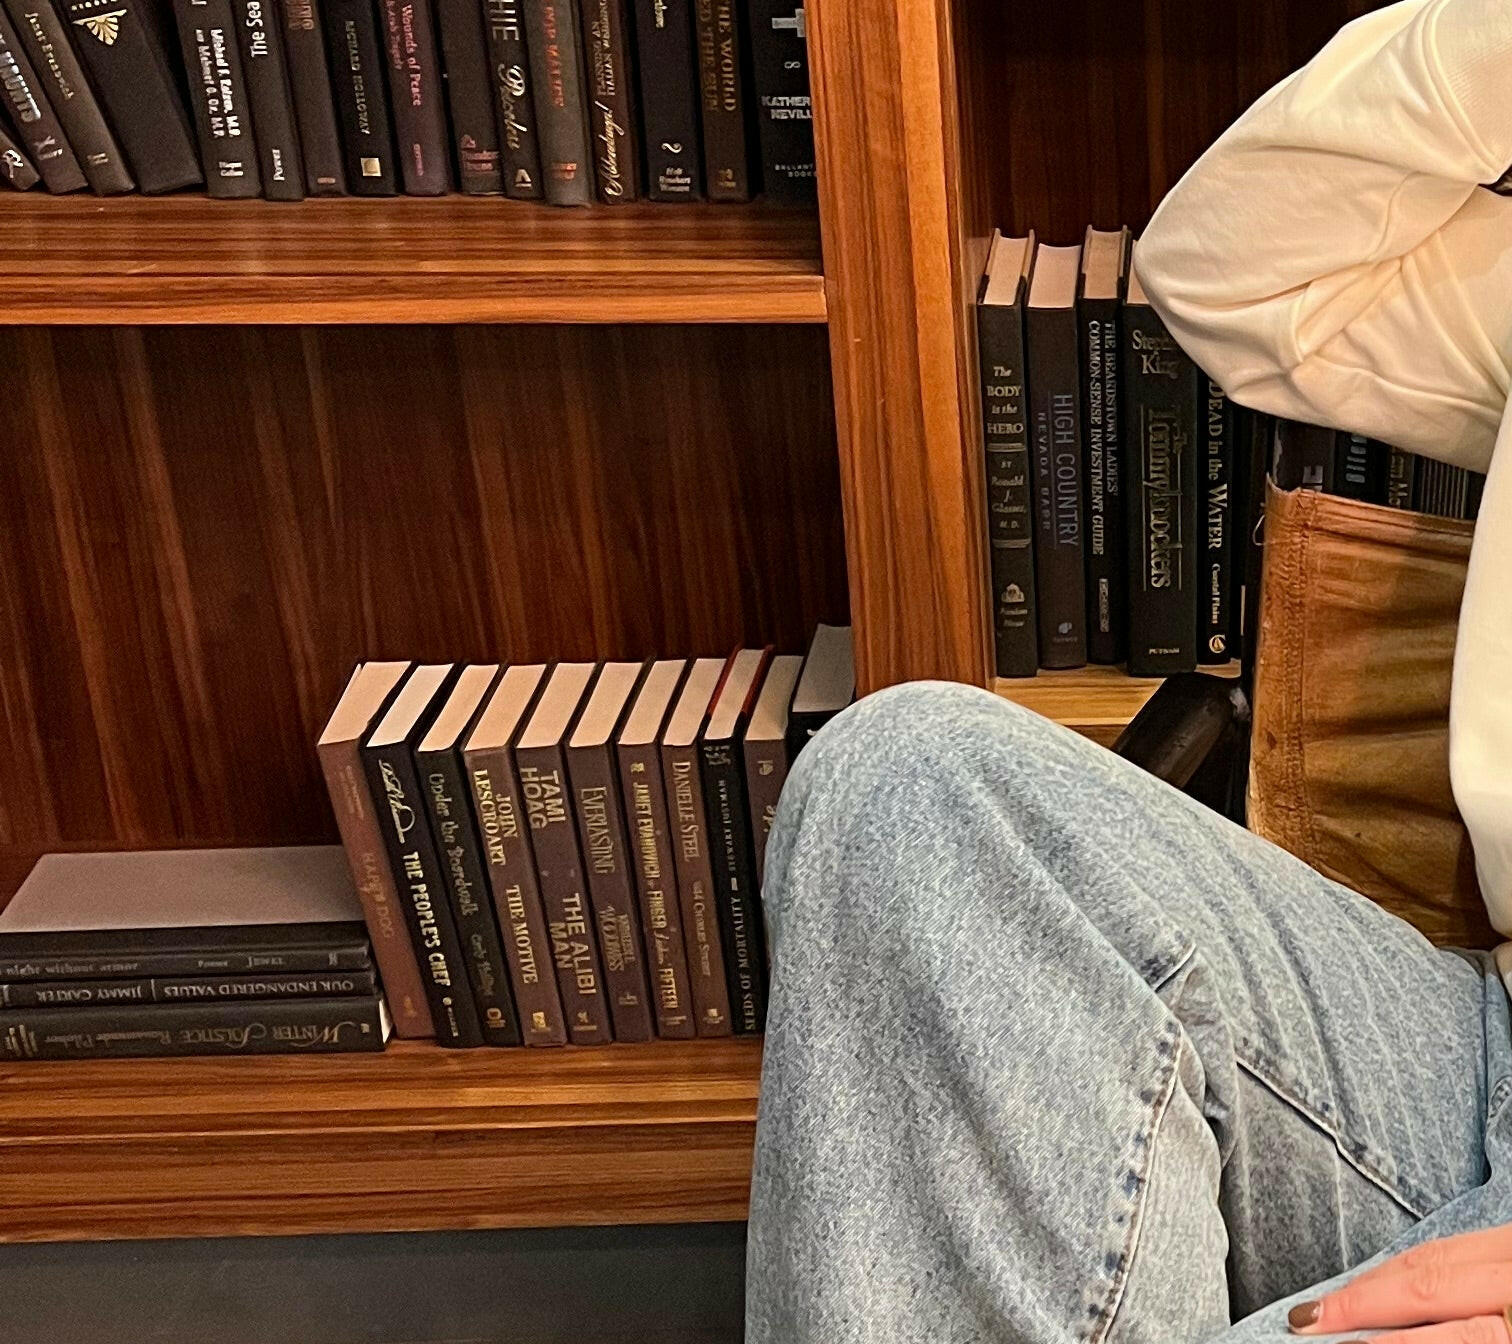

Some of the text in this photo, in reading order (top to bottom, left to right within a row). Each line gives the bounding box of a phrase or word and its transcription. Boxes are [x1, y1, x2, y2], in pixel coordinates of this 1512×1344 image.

[245, 1, 263, 28] Sea
[251, 31, 268, 58] The
[987, 385, 1021, 398] BODY
[987, 421, 1024, 435] HERO
[1053, 394, 1080, 548] HIGH COUNTRY
[1208, 440, 1228, 550] in the WATER
[474, 769, 506, 865] LESCROART
[496, 793, 518, 838] JOHN
[520, 767, 547, 829] HOAG
[539, 770, 566, 823] TAMI
[672, 762, 695, 822] DANIELLE
[581, 786, 615, 874] EVERLASTING
[633, 783, 660, 878] JANET EVANOVICH
[402, 851, 450, 987] THE PEOPLE'S CHEF
[505, 885, 538, 984] THE MOTIVE
[549, 922, 574, 969] MAN
[562, 893, 596, 995] THE ALIBI
